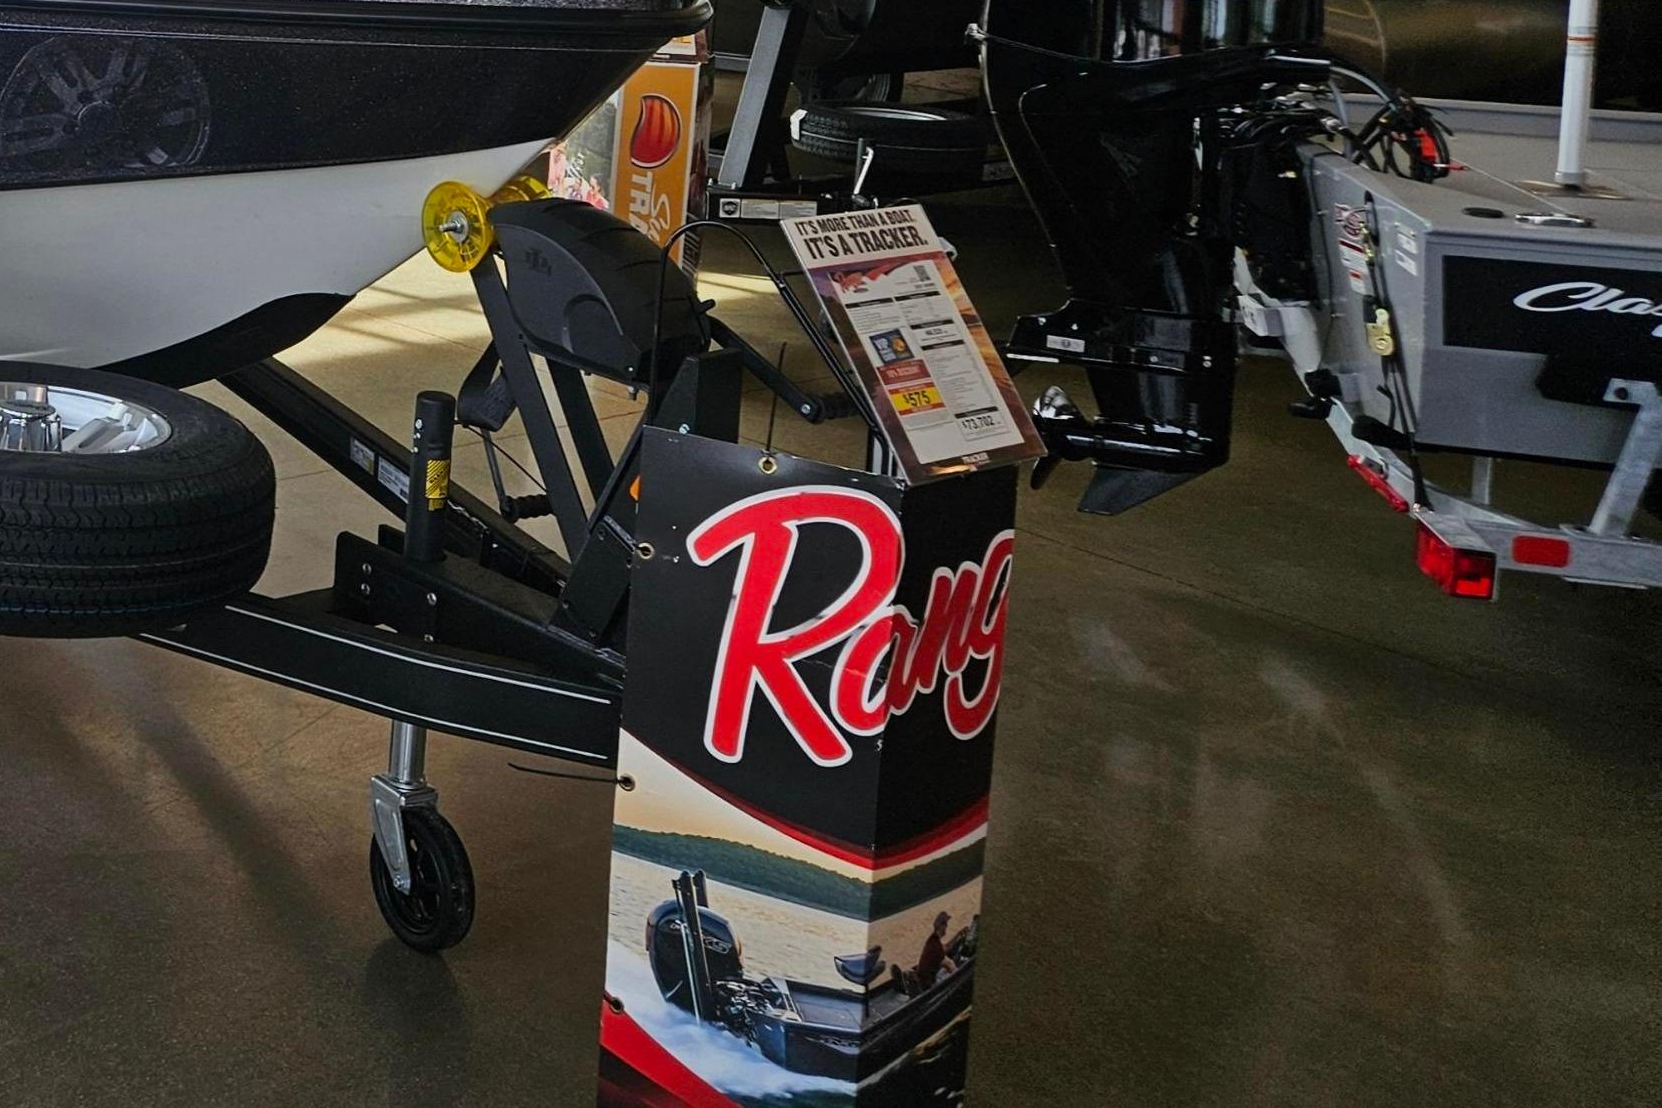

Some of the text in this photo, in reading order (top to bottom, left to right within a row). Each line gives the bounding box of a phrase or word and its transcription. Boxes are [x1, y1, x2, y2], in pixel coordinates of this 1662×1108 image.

[794, 220, 819, 236] IT'S
[817, 216, 850, 233] MORE
[850, 213, 881, 229] THAN
[879, 211, 888, 226] A
[803, 226, 929, 259] IT'S A TRACKER.
[902, 390, 931, 407] $575
[686, 485, 1015, 767] Rang
